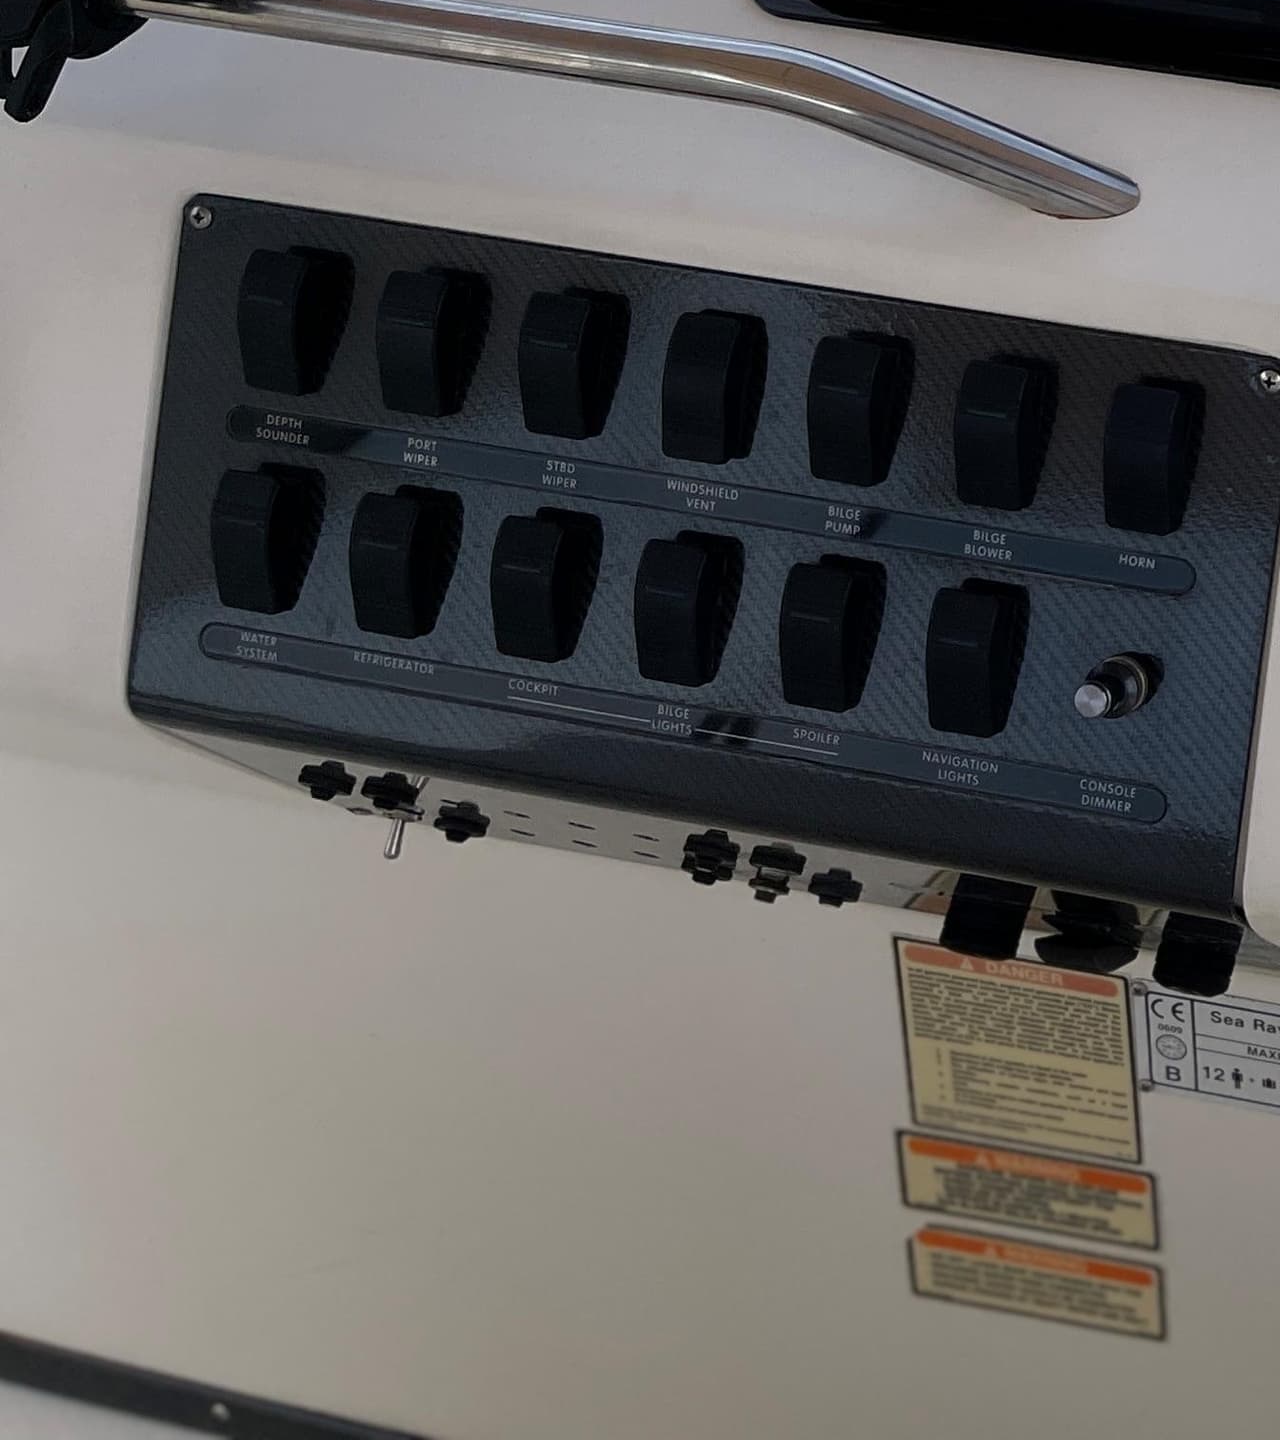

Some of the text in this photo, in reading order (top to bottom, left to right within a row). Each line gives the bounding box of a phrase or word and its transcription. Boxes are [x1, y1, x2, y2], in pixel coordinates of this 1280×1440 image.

[266, 414, 303, 429] DEPTH
[256, 427, 310, 446] SOUNDER
[407, 437, 438, 452] PORT
[403, 452, 439, 468] WIPER
[546, 460, 576, 475] STBD
[542, 474, 577, 490] WIPER
[666, 479, 739, 501] WINDSHIELD
[686, 497, 716, 512] VENT
[827, 505, 862, 521] BILGE
[824, 521, 861, 536] PUMP
[973, 530, 1007, 546] BILGE
[964, 543, 1013, 561] BLOWER
[1119, 554, 1156, 569] HORN
[240, 631, 278, 647] WATER
[236, 645, 278, 662] SYSTEM
[353, 650, 434, 675] REFRIGERATOR
[508, 679, 560, 697] COCKPIT
[658, 704, 690, 720] BILGE
[651, 719, 693, 736] LIGHTS
[793, 727, 841, 746] SPOILER
[922, 750, 999, 774] NAVIGATION
[938, 769, 980, 787] LIGHTS
[1079, 778, 1136, 799] CONSOLE
[1081, 794, 1132, 813] DIMMER
[985, 961, 1064, 986] DANGER
[1210, 1010, 1245, 1028] Sea
[1165, 1065, 1182, 1082] B
[1203, 1066, 1225, 1082] 12
